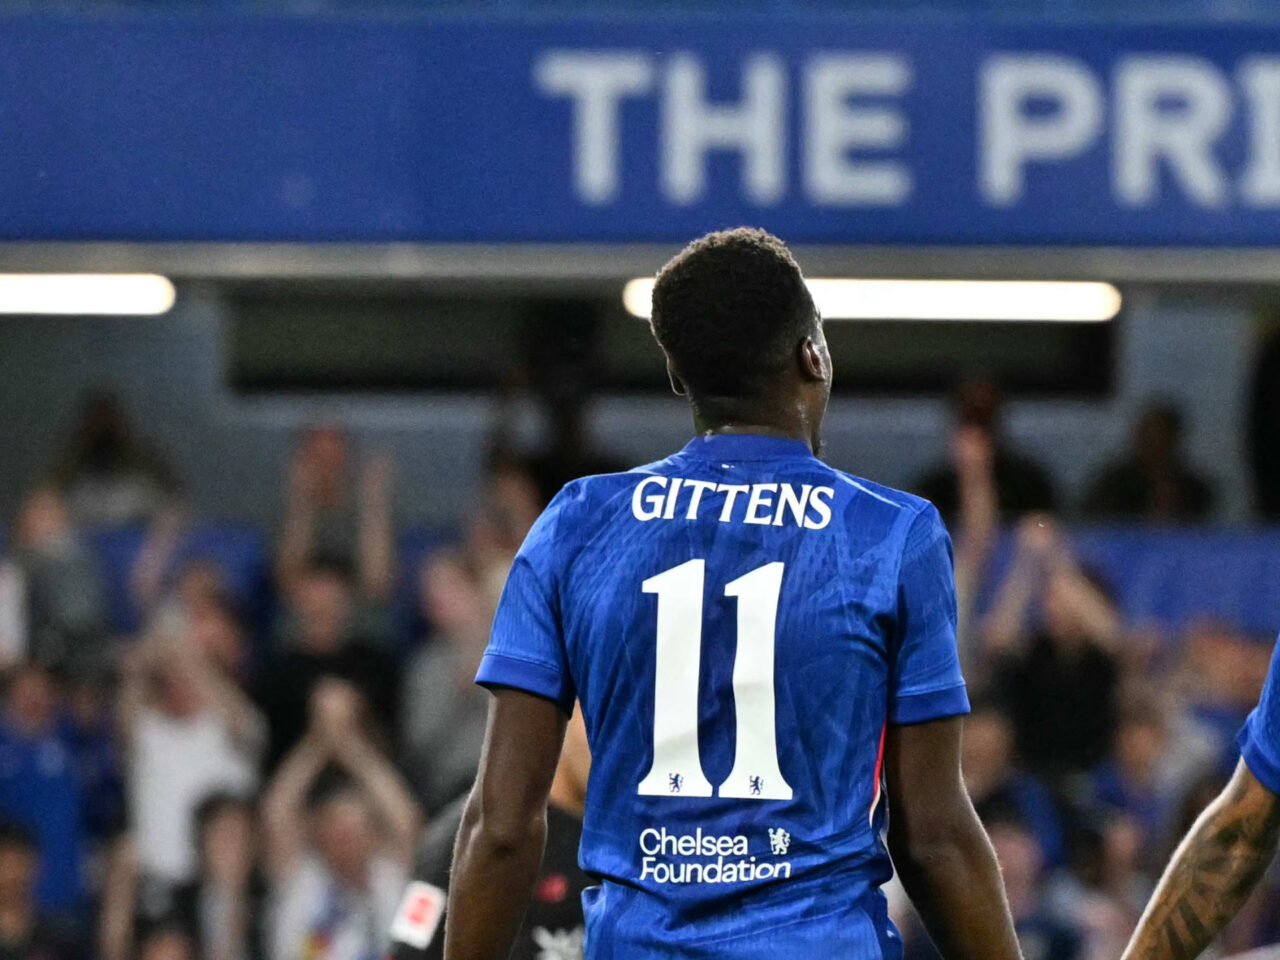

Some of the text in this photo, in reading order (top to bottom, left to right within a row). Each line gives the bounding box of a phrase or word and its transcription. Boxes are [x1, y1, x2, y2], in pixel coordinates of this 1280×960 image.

[536, 51, 911, 205] THE
[631, 476, 834, 530] GITTENS
[637, 558, 794, 800] 11
[639, 827, 749, 856] Chelsea
[639, 856, 791, 883] Foundation
